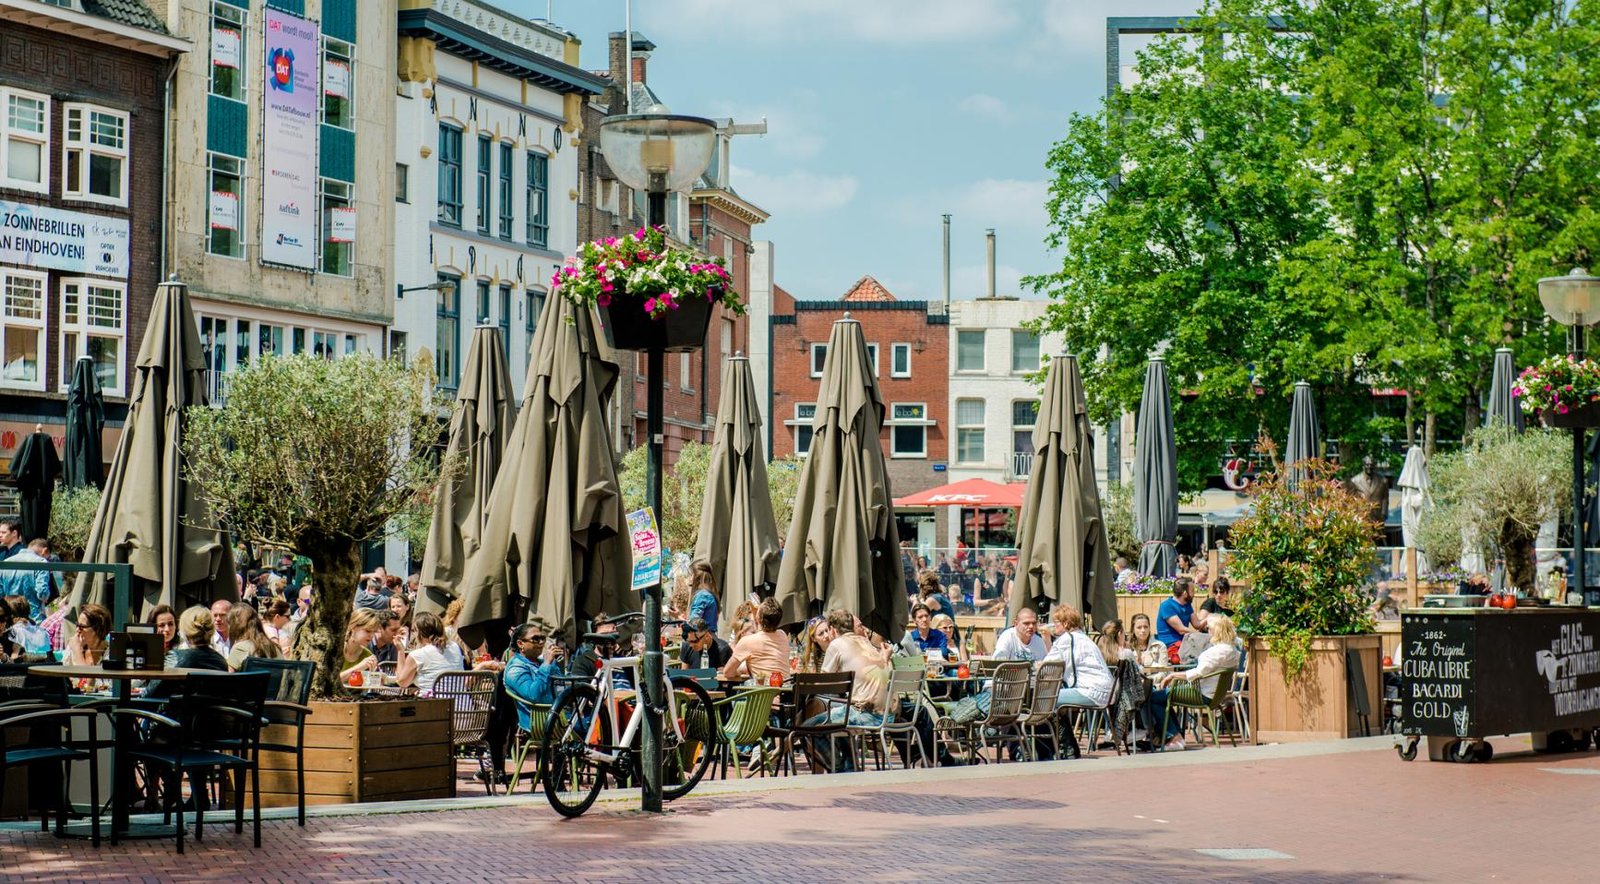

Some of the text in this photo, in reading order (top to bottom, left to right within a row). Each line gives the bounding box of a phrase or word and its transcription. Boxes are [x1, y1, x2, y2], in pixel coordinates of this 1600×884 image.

[269, 20, 281, 31] DAT
[276, 63, 289, 76] DAT
[4, 213, 85, 239] ZONNEBRILLEN
[15, 237, 85, 260] EINDHOVEN!
[927, 494, 988, 502] KFC
[1560, 622, 1583, 655] GLAS
[1410, 641, 1466, 661] The Original
[1403, 660, 1471, 679] CUBA LIBRE
[1412, 683, 1463, 698] BACARDI
[1412, 701, 1451, 718] GOLD
